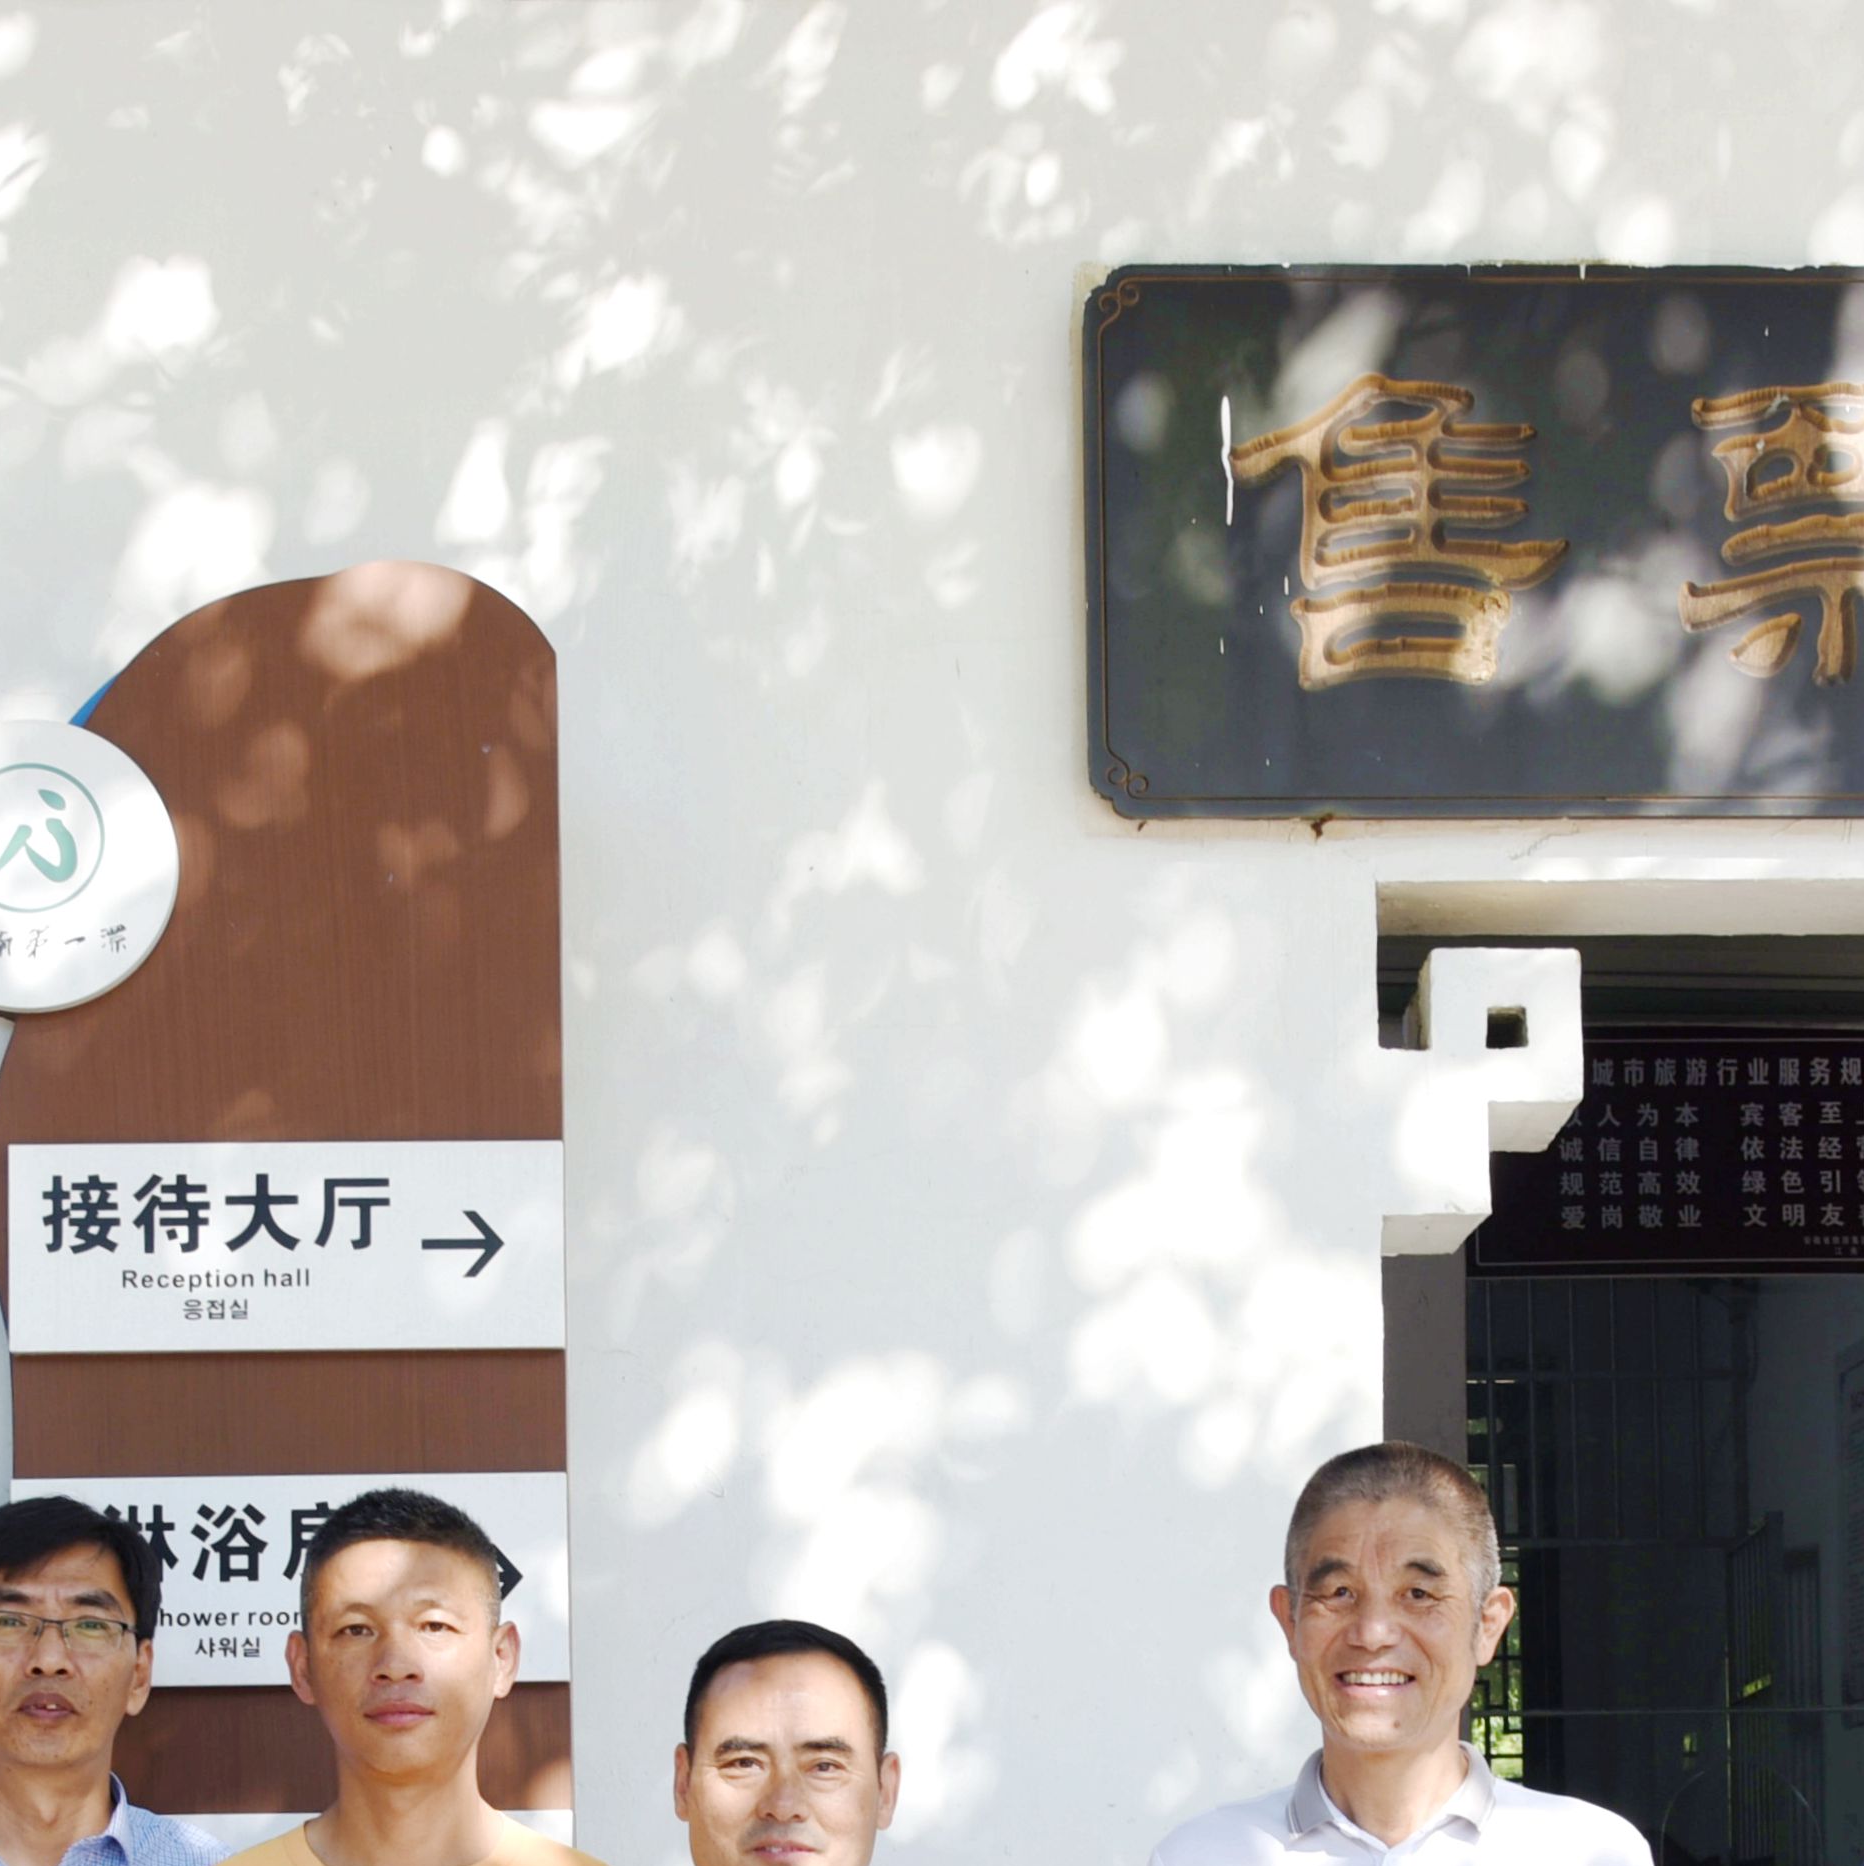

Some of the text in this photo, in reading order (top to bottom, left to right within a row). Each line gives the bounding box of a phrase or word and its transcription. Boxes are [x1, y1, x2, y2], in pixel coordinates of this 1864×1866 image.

[1560, 1137, 1700, 1163] 诚信自律
[1560, 1171, 1701, 1196] 规范高效
[41, 1173, 391, 1254] 接待大厅
[1561, 1205, 1702, 1230] 爱岗敬业
[122, 1268, 311, 1292] Reception hall
[182, 1298, 250, 1321] 응접실
[159, 1608, 240, 1627] hower
[194, 1637, 261, 1658] 샤워실
